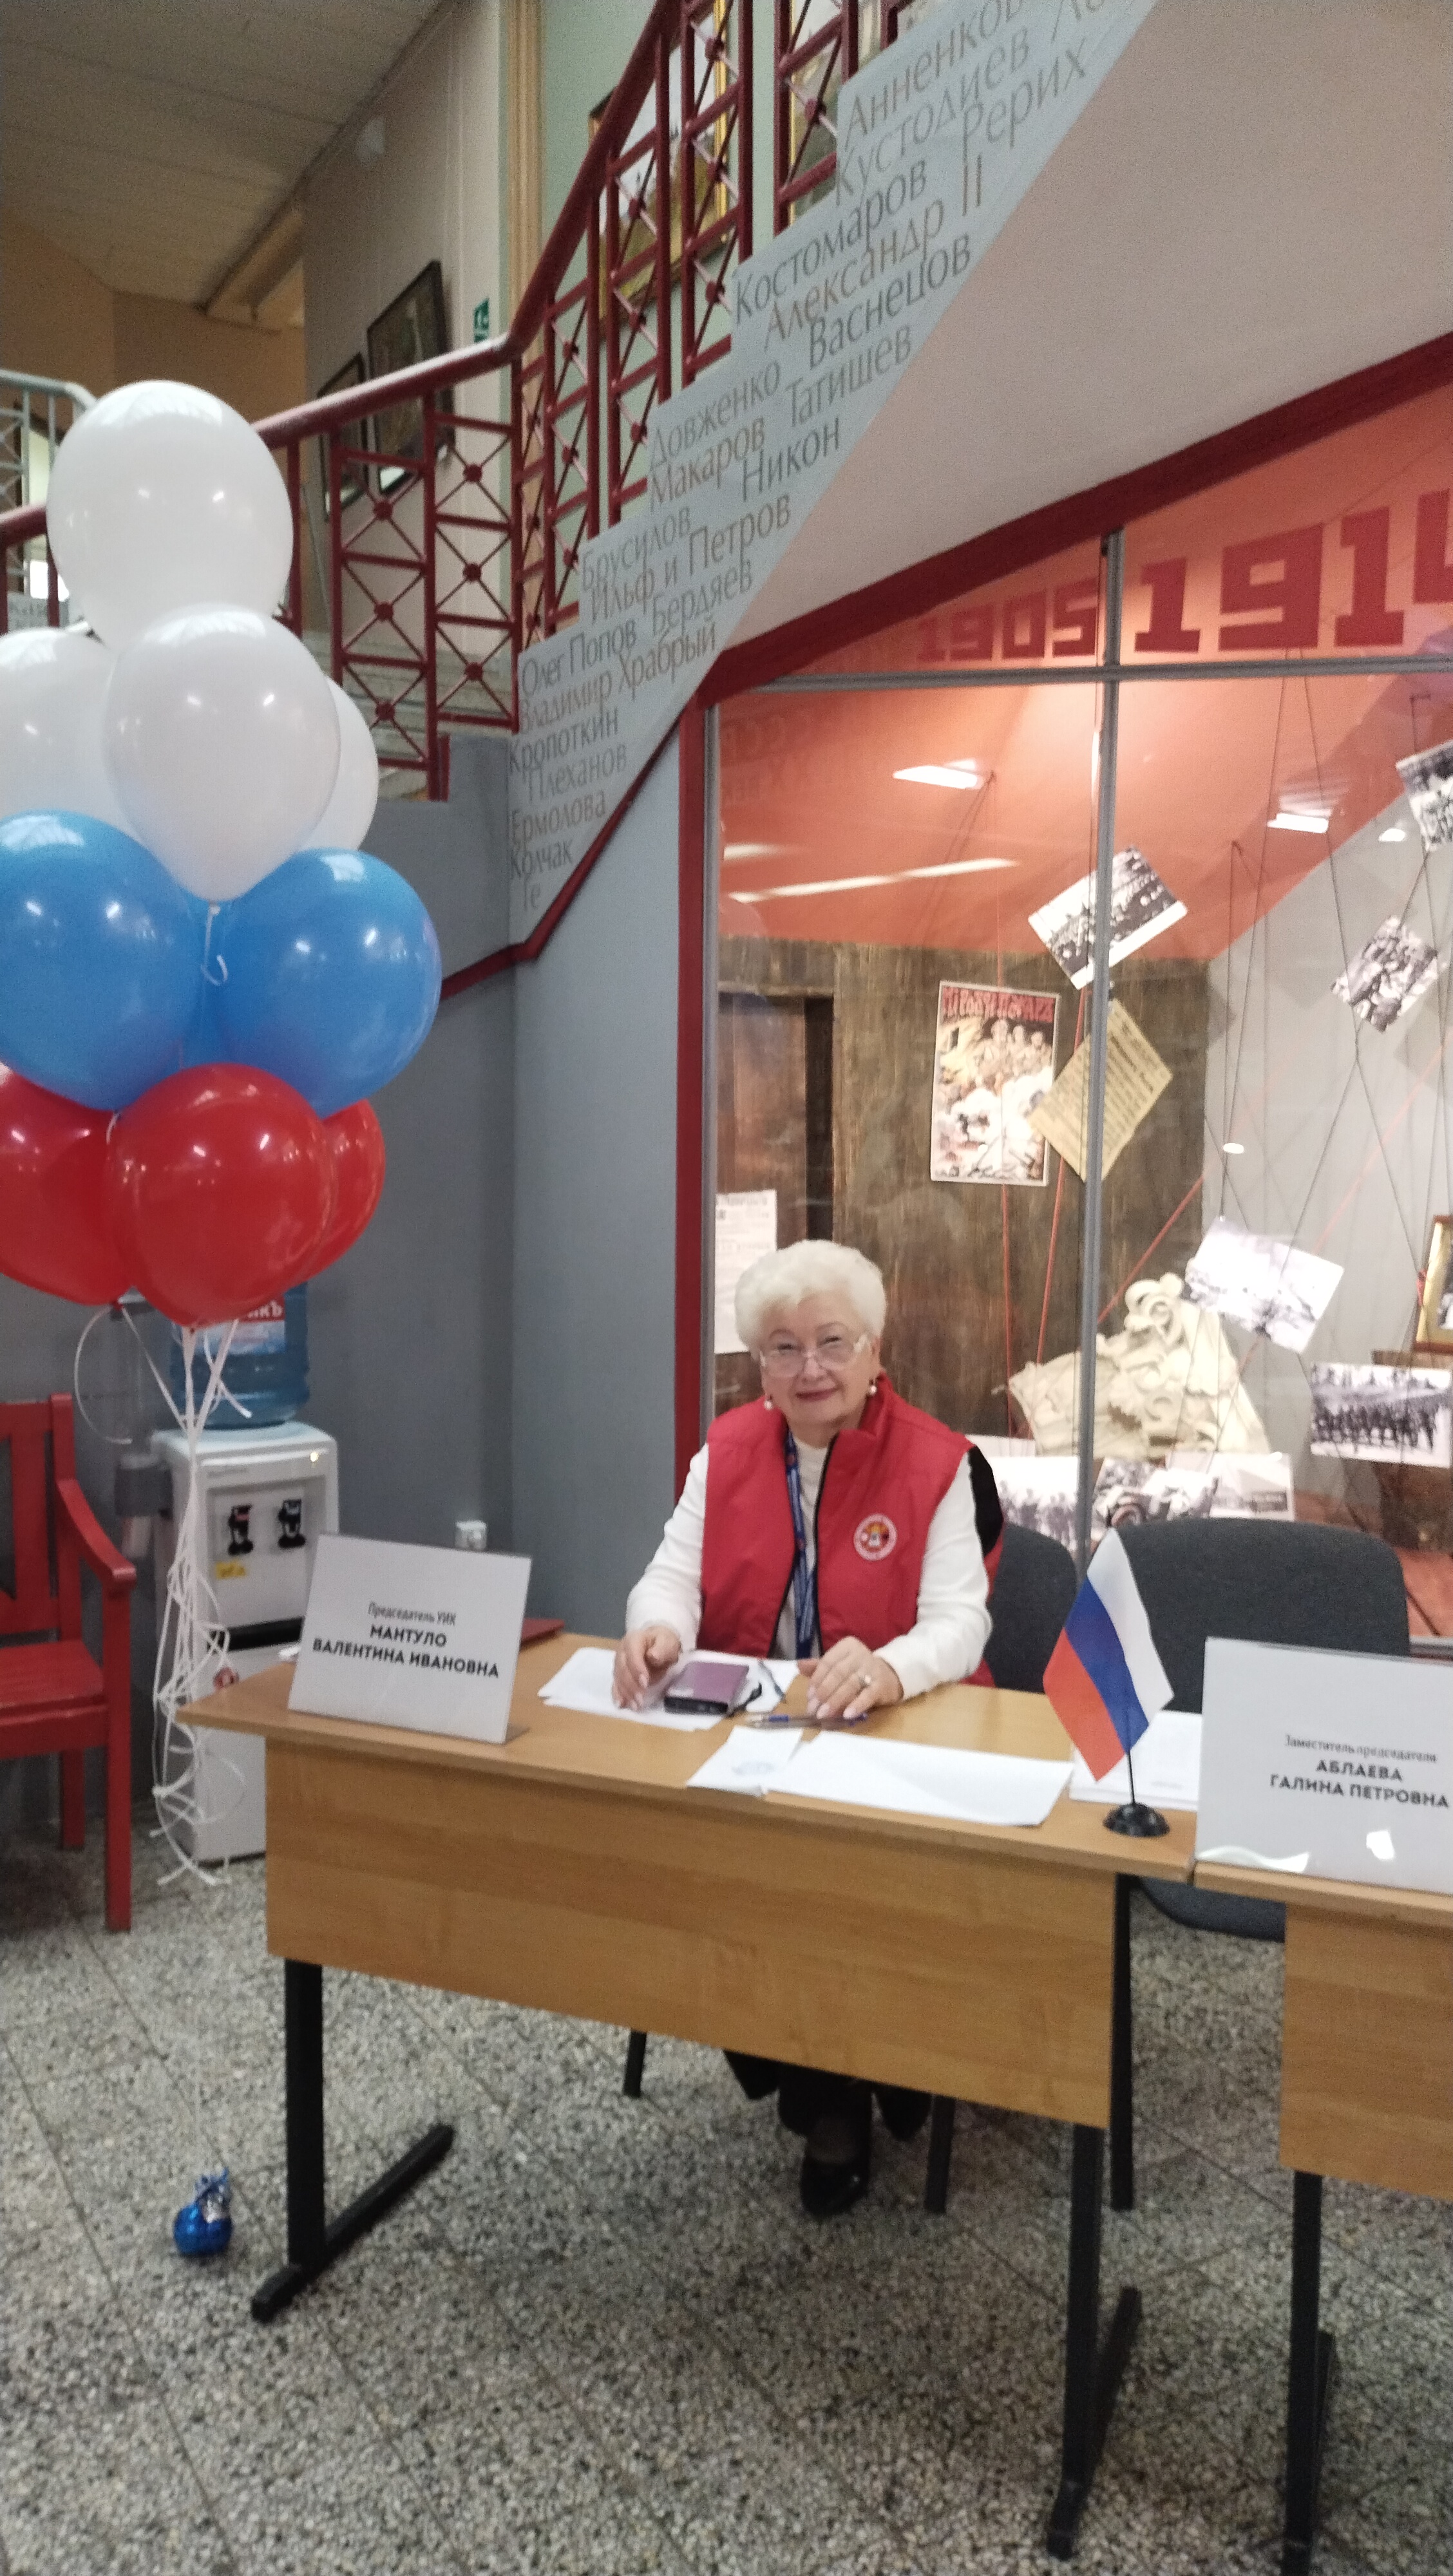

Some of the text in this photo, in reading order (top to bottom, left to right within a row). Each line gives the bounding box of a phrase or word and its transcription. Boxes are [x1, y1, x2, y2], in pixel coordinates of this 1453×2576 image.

[837, 26, 1030, 206] Кустодиев
[736, 37, 1087, 327] Костомаров Рерих
[765, 198, 945, 352] Александр
[649, 234, 971, 472] Довженко Васнецов
[581, 417, 840, 594] Брусилов Никон
[650, 416, 766, 512] Макаров
[591, 558, 656, 625] Ильф
[688, 494, 790, 576] Петров
[520, 560, 752, 697] Олег Попов Бердяев
[618, 614, 717, 701] Храбрый
[917, 578, 1097, 661] 1905
[509, 707, 619, 774] Кропоткин
[527, 744, 627, 802] Плеханов
[510, 790, 606, 850] Ермолова
[510, 838, 573, 880] Колчак
[312, 1638, 499, 1678] ВАЛЕНТИНА ИВАНОВНА
[370, 1624, 447, 1647] МАНТУЛО
[1269, 1773, 1450, 1808] ГАЛИНА ПЕТРОВНА
[1316, 1759, 1403, 1782] АБЛАЕВА
